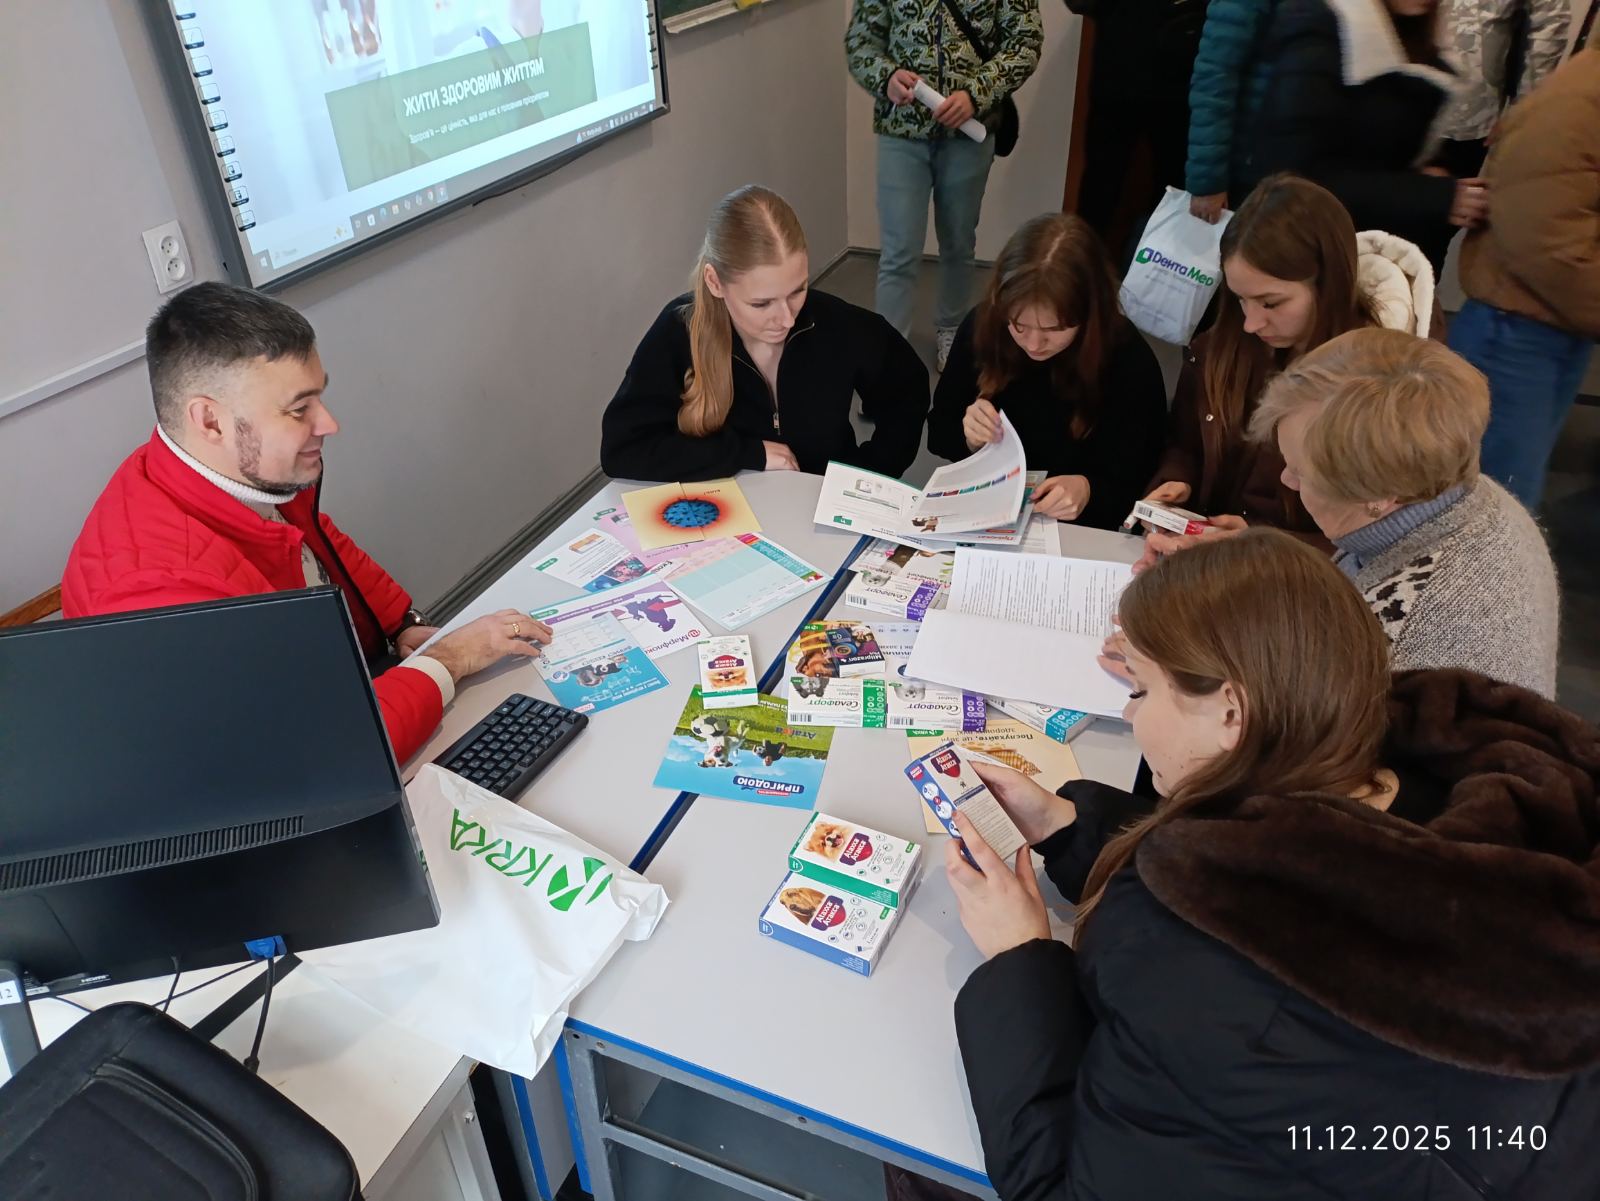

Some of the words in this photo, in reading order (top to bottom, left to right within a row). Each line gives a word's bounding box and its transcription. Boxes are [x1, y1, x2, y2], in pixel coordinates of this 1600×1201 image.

[403, 89, 440, 117] ЖИТИ
[440, 70, 501, 106] ЗДОРОВИМ
[502, 57, 545, 86] ЖИТТЯМ
[808, 699, 859, 708] Селафорт
[907, 702, 959, 713] Селафорт
[975, 733, 1034, 742] Послухайте,
[737, 777, 801, 793] ПРИГОДОЮ
[451, 808, 553, 887] KRKA
[815, 900, 833, 923] Ataxxa
